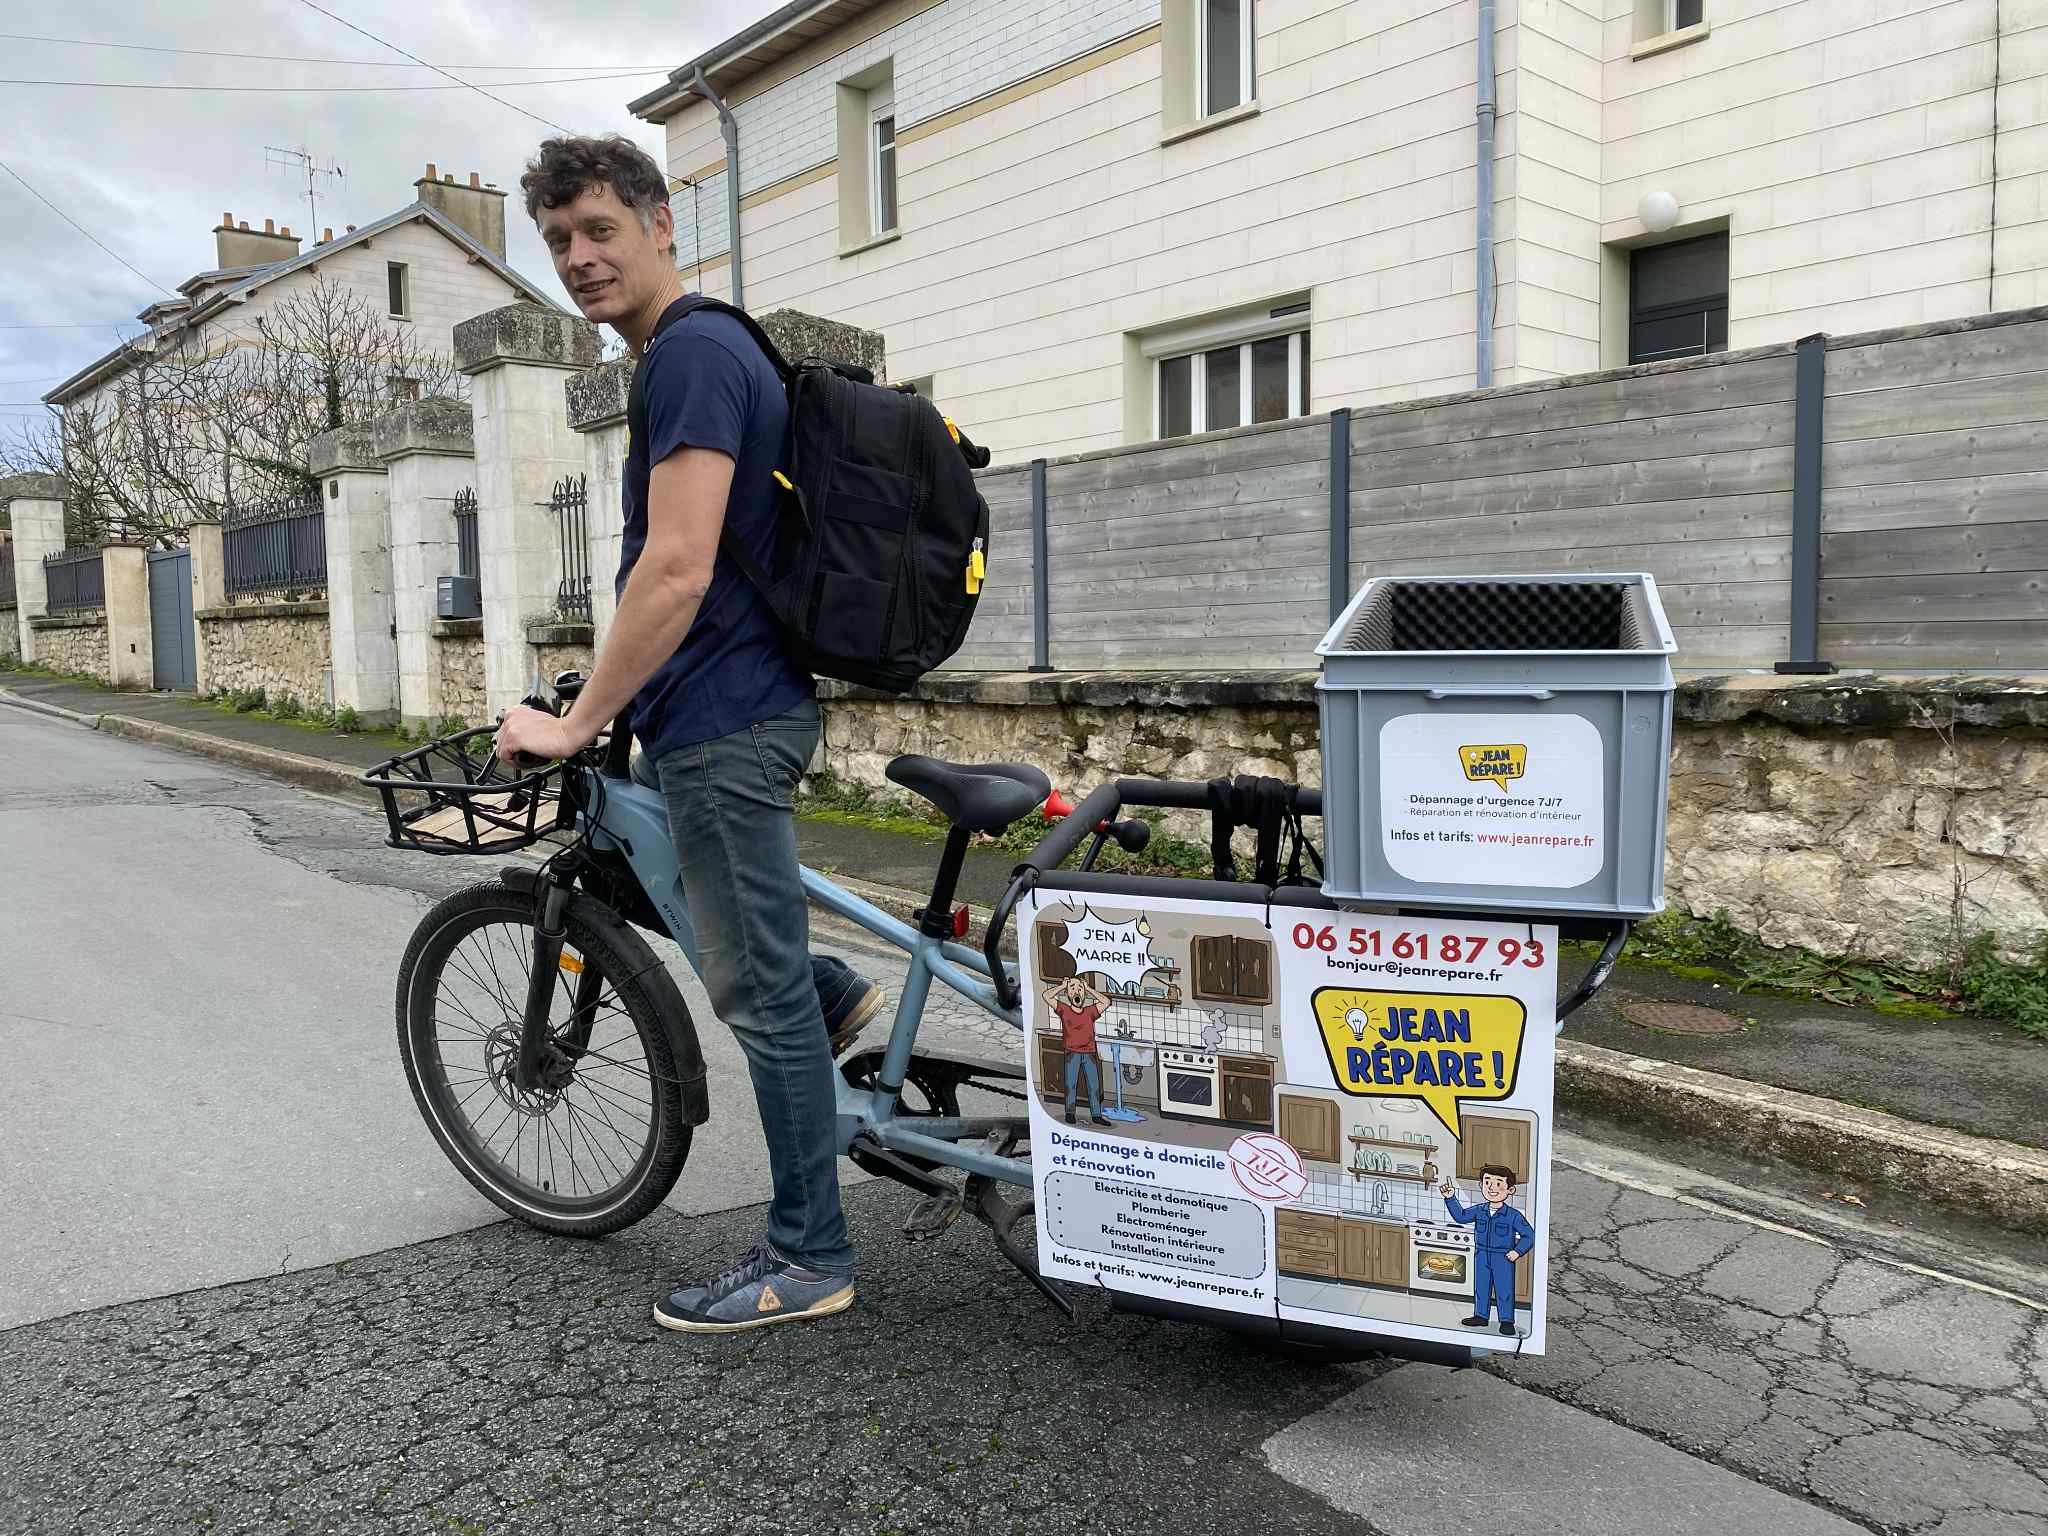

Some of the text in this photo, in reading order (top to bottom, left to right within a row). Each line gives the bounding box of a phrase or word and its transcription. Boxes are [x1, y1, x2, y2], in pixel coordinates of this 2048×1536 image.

[1480, 749, 1511, 762] JEAN
[1409, 794, 1563, 807] Dépannage d'urgence 7J/7
[1410, 807, 1461, 818] Réparation
[1463, 809, 1473, 817] et
[1475, 809, 1528, 819] rénovation
[1390, 829, 1595, 848] Infos et tarifs: www.jeanrepare.fr
[1083, 928, 1136, 945] J'EN AI
[1292, 922, 1545, 968] 06 51 61 87 93
[1075, 948, 1146, 966] MARRE !!
[1327, 956, 1503, 982] bonjour@jeanrepare.fr
[1379, 1006, 1471, 1043] JEAN
[1346, 1041, 1505, 1089] RÉPARE !
[1051, 1132, 1226, 1171] Dépannage à domicile
[1052, 1154, 1156, 1180] et rénovation
[1131, 1201, 1191, 1221] Plomberie
[1150, 1189, 1163, 1201] et
[1165, 1191, 1229, 1213] domotique
[1116, 1213, 1207, 1238] Electroménager
[1101, 1224, 1225, 1254] Rénovation intérieure
[1111, 1240, 1216, 1267] Installation cuisine
[1052, 1252, 1265, 1300] Infos et tarifs: www.jeanrepare.fr
